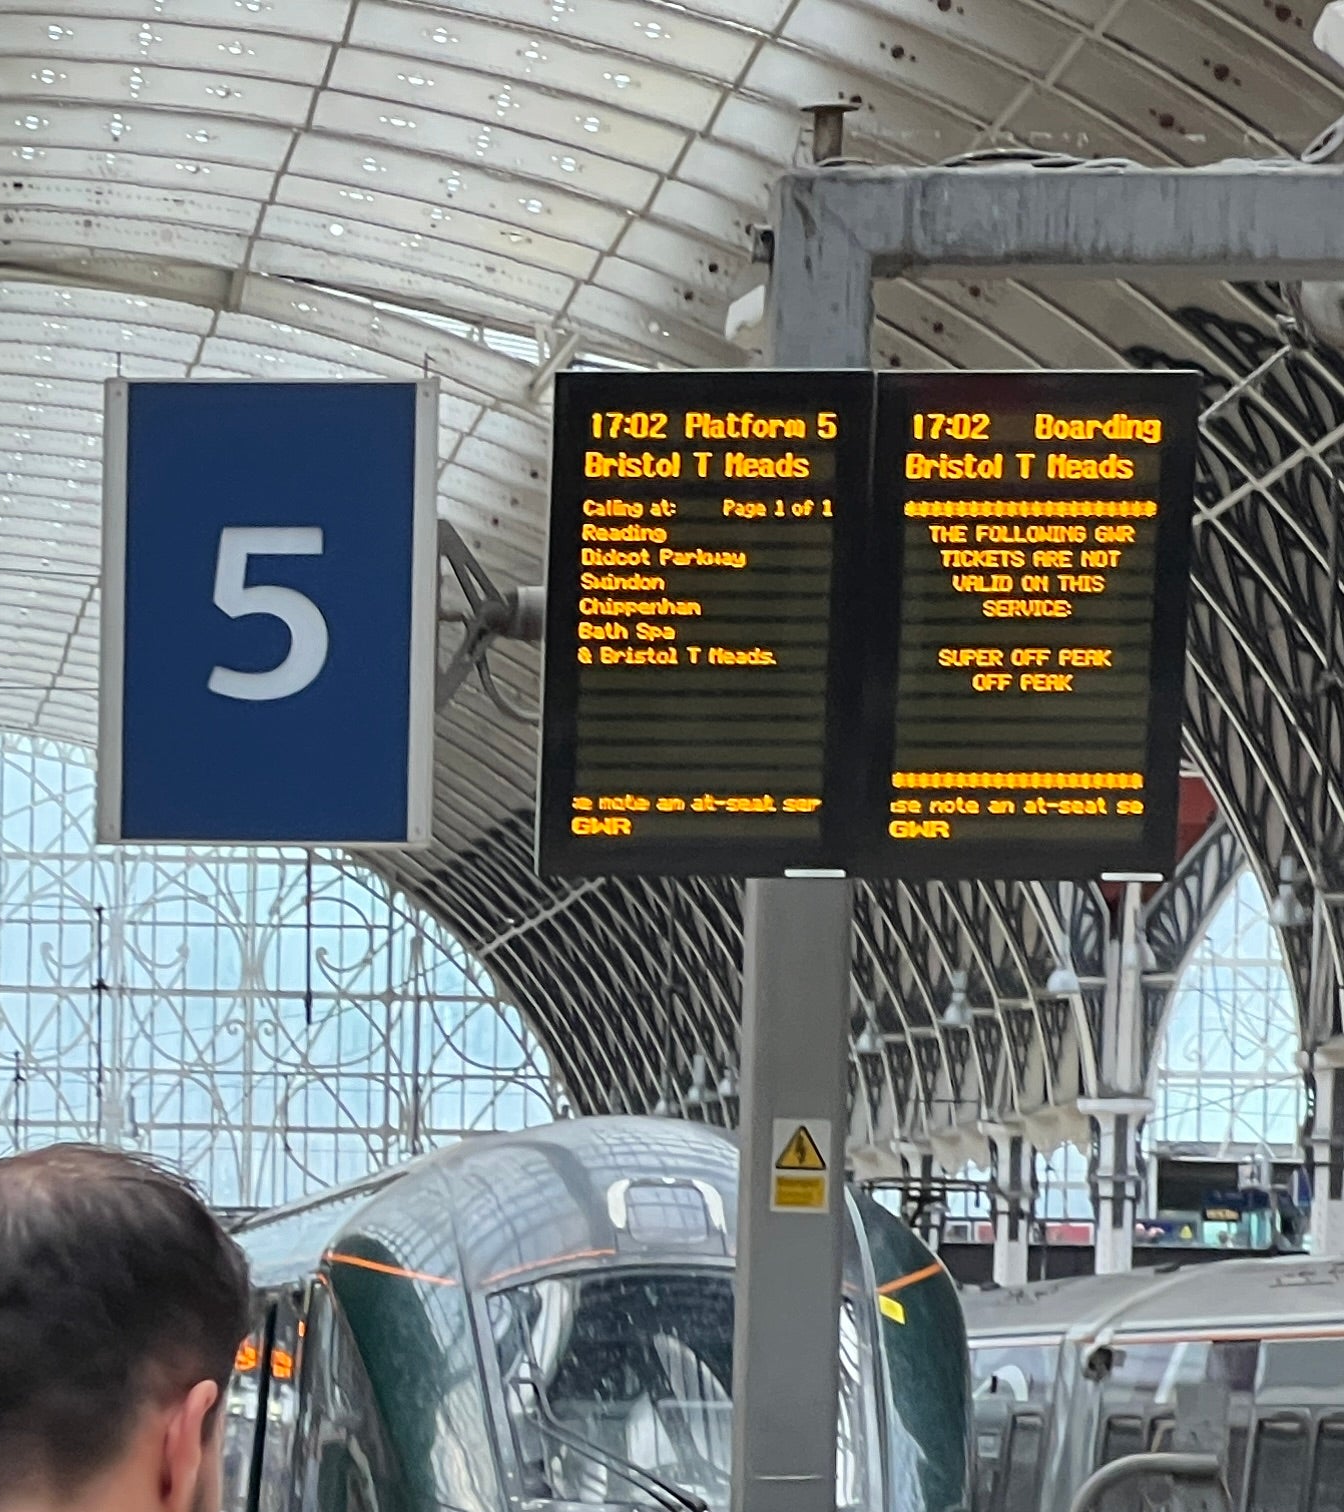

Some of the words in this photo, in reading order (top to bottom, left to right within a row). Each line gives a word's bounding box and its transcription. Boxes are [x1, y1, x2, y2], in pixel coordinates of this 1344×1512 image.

[591, 411, 668, 439] 17:02
[685, 411, 806, 439] Platform
[817, 412, 837, 439] 5
[913, 413, 992, 440] 17:02
[1034, 413, 1162, 444] Boarding
[584, 451, 681, 478] Bristol
[692, 451, 713, 478] T
[724, 452, 810, 478] Meads
[905, 453, 1004, 480] Bristol
[1015, 453, 1036, 480] T
[1047, 453, 1134, 480] Meads
[582, 499, 644, 519] Calling
[649, 498, 677, 517] at:
[722, 499, 767, 519] Page
[774, 499, 785, 517] 1
[791, 499, 815, 517] of
[822, 499, 833, 517] 1
[581, 523, 668, 544] Reading
[928, 524, 969, 544] THE
[975, 524, 1088, 544] FOLLOWING
[1094, 525, 1136, 544] GWR
[581, 547, 651, 566] Didcot
[659, 548, 747, 568] Parkway
[940, 549, 1026, 568] TICKETS
[1032, 549, 1074, 568] ARE
[1080, 549, 1122, 568] NOT
[580, 571, 666, 591] Swindon
[952, 574, 1014, 593] VALID
[1020, 574, 1049, 593] ON
[1056, 574, 1105, 593] THIS
[207, 526, 330, 701] 5
[578, 621, 629, 640] Bath
[635, 622, 676, 642] Spa
[599, 646, 679, 665] Bristol
[686, 646, 702, 664] T
[938, 648, 1004, 667] SUPER
[1010, 648, 1052, 667] OFF
[1058, 648, 1112, 667] PEAK
[972, 673, 1013, 692] OFF
[1019, 673, 1074, 692] PEAK
[655, 797, 686, 812] an
[690, 793, 777, 813] at-seat
[929, 796, 980, 814] note
[987, 800, 1016, 814] an
[1022, 796, 1108, 815] at-seat
[571, 816, 632, 836] GWR
[888, 820, 950, 839] GWR
